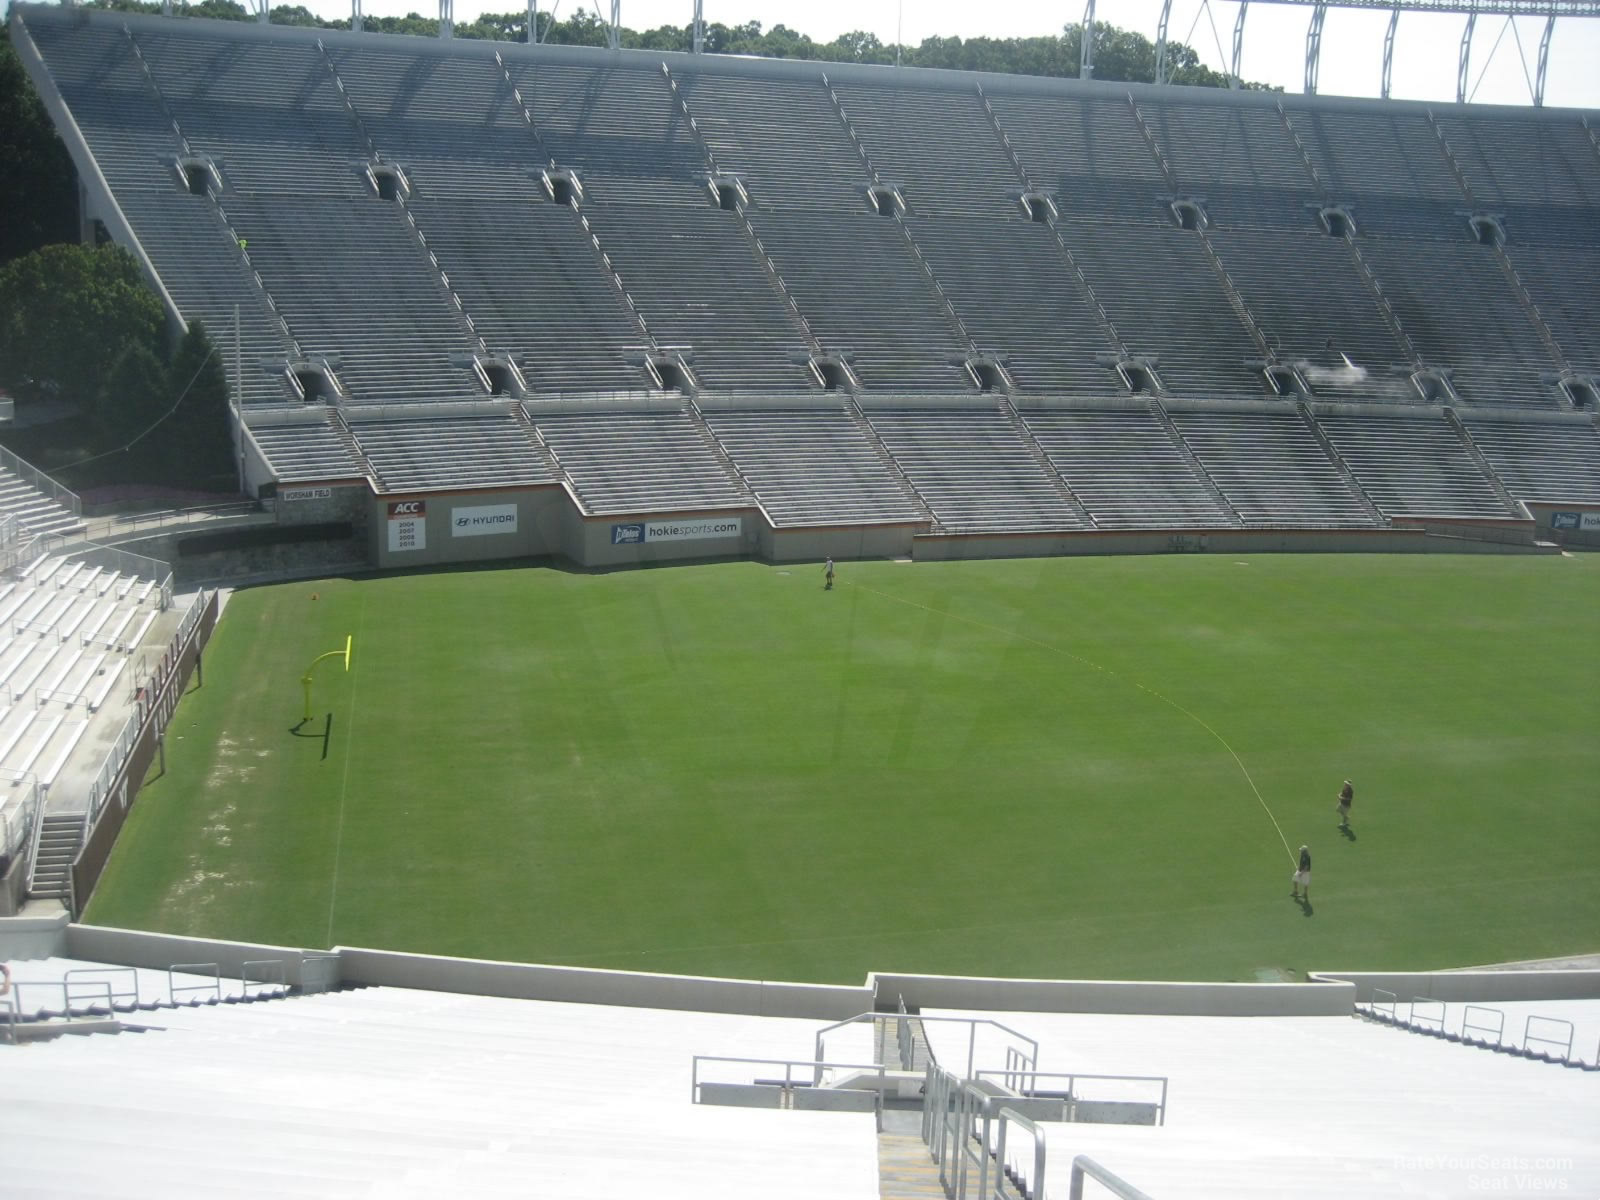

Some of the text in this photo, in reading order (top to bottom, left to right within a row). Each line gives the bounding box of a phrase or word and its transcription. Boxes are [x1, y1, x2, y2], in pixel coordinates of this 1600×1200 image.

[314, 489, 330, 498] FIELD
[394, 502, 420, 514] ACC
[473, 515, 515, 525] HYUNDAI
[649, 523, 737, 537] hokiesports.com
